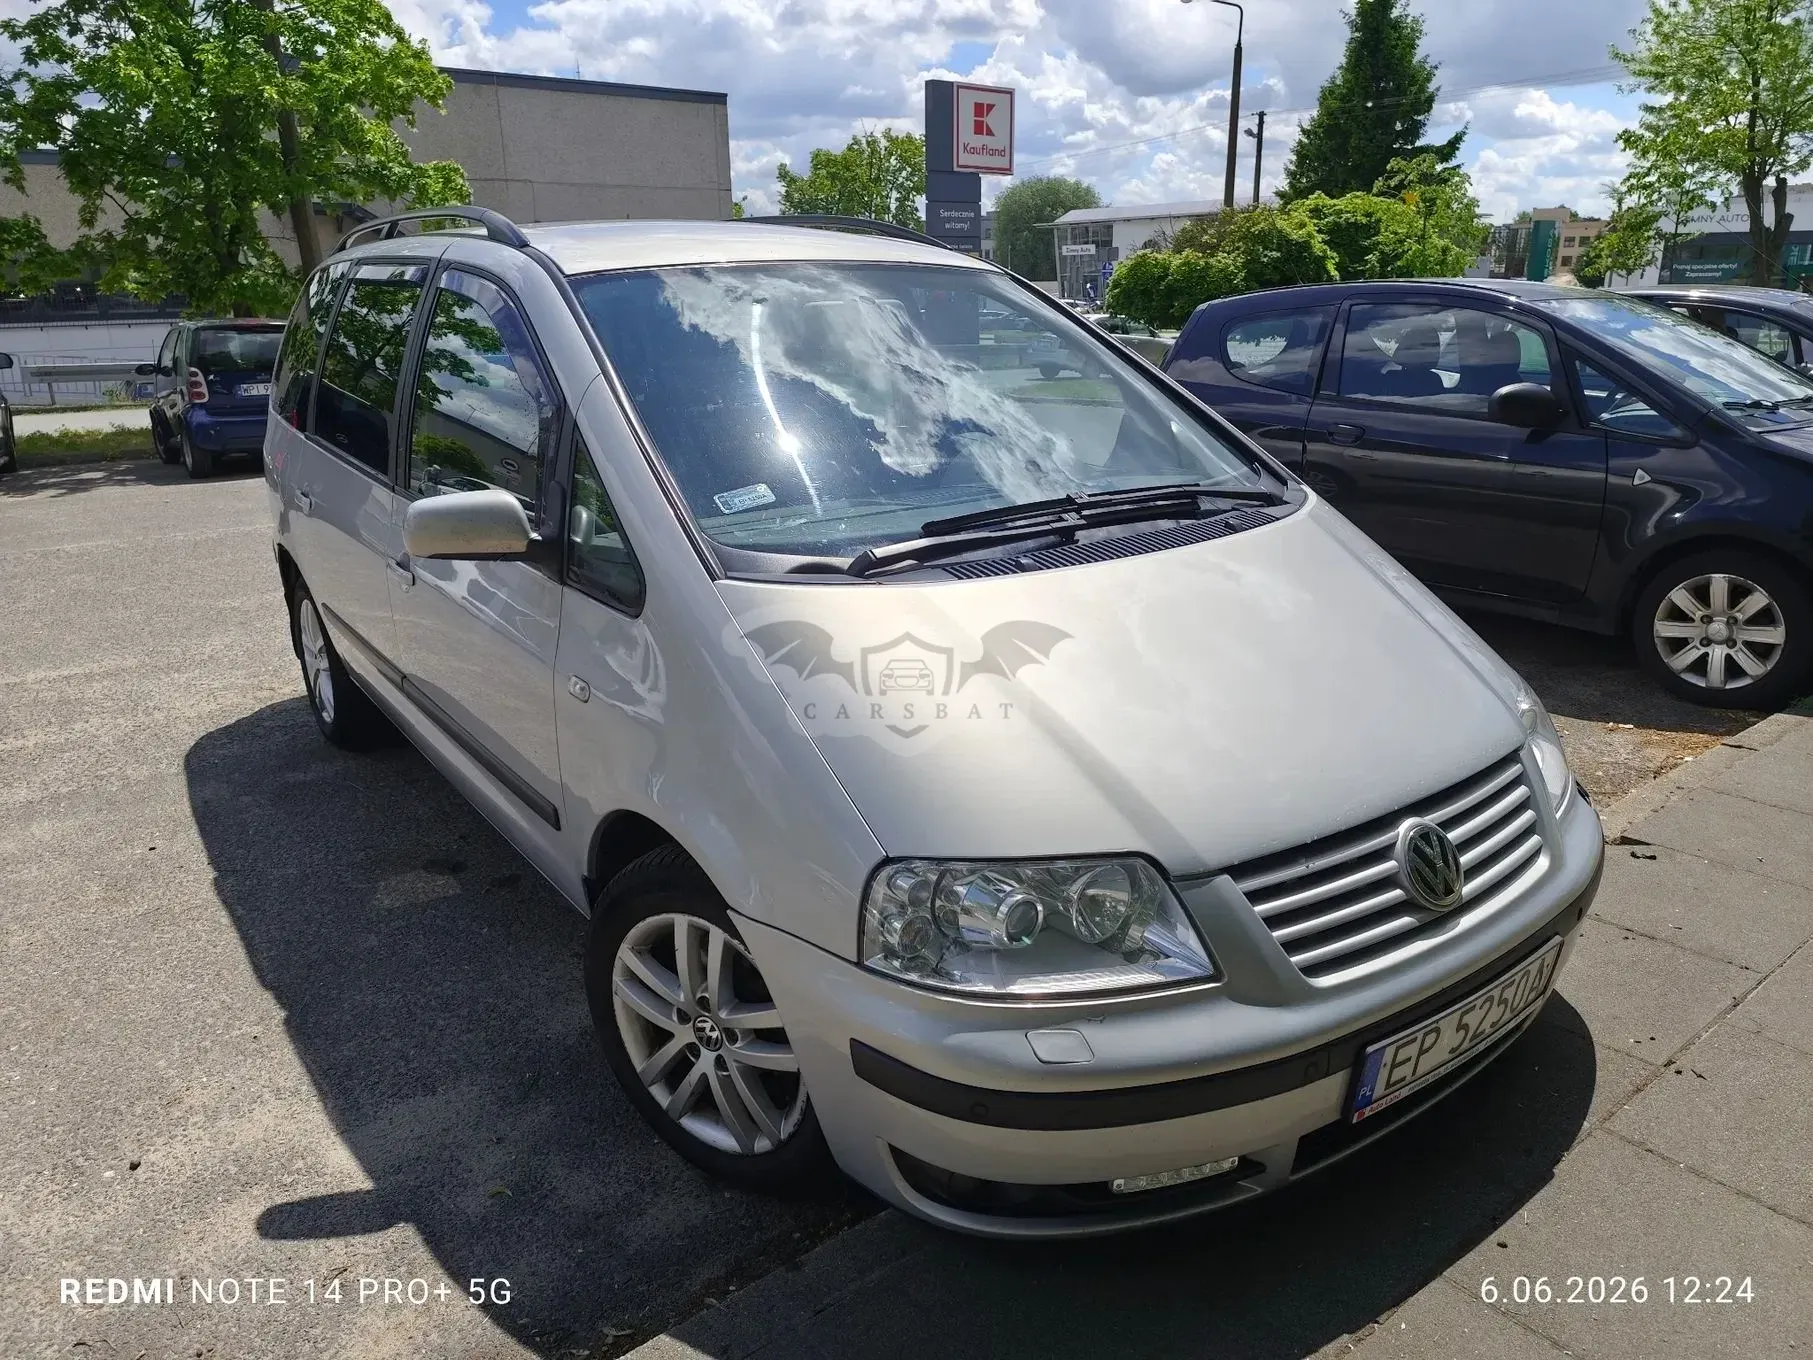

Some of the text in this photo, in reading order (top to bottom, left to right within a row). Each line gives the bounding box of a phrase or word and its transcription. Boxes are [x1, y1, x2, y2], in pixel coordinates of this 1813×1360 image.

[963, 142, 1006, 158] Kaufland
[940, 208, 975, 217] Serdecznie
[1719, 213, 1750, 223] AUTO
[1384, 1025, 1442, 1091] EP
[1448, 956, 1546, 1055] 5250A
[1358, 1084, 1373, 1100] PL
